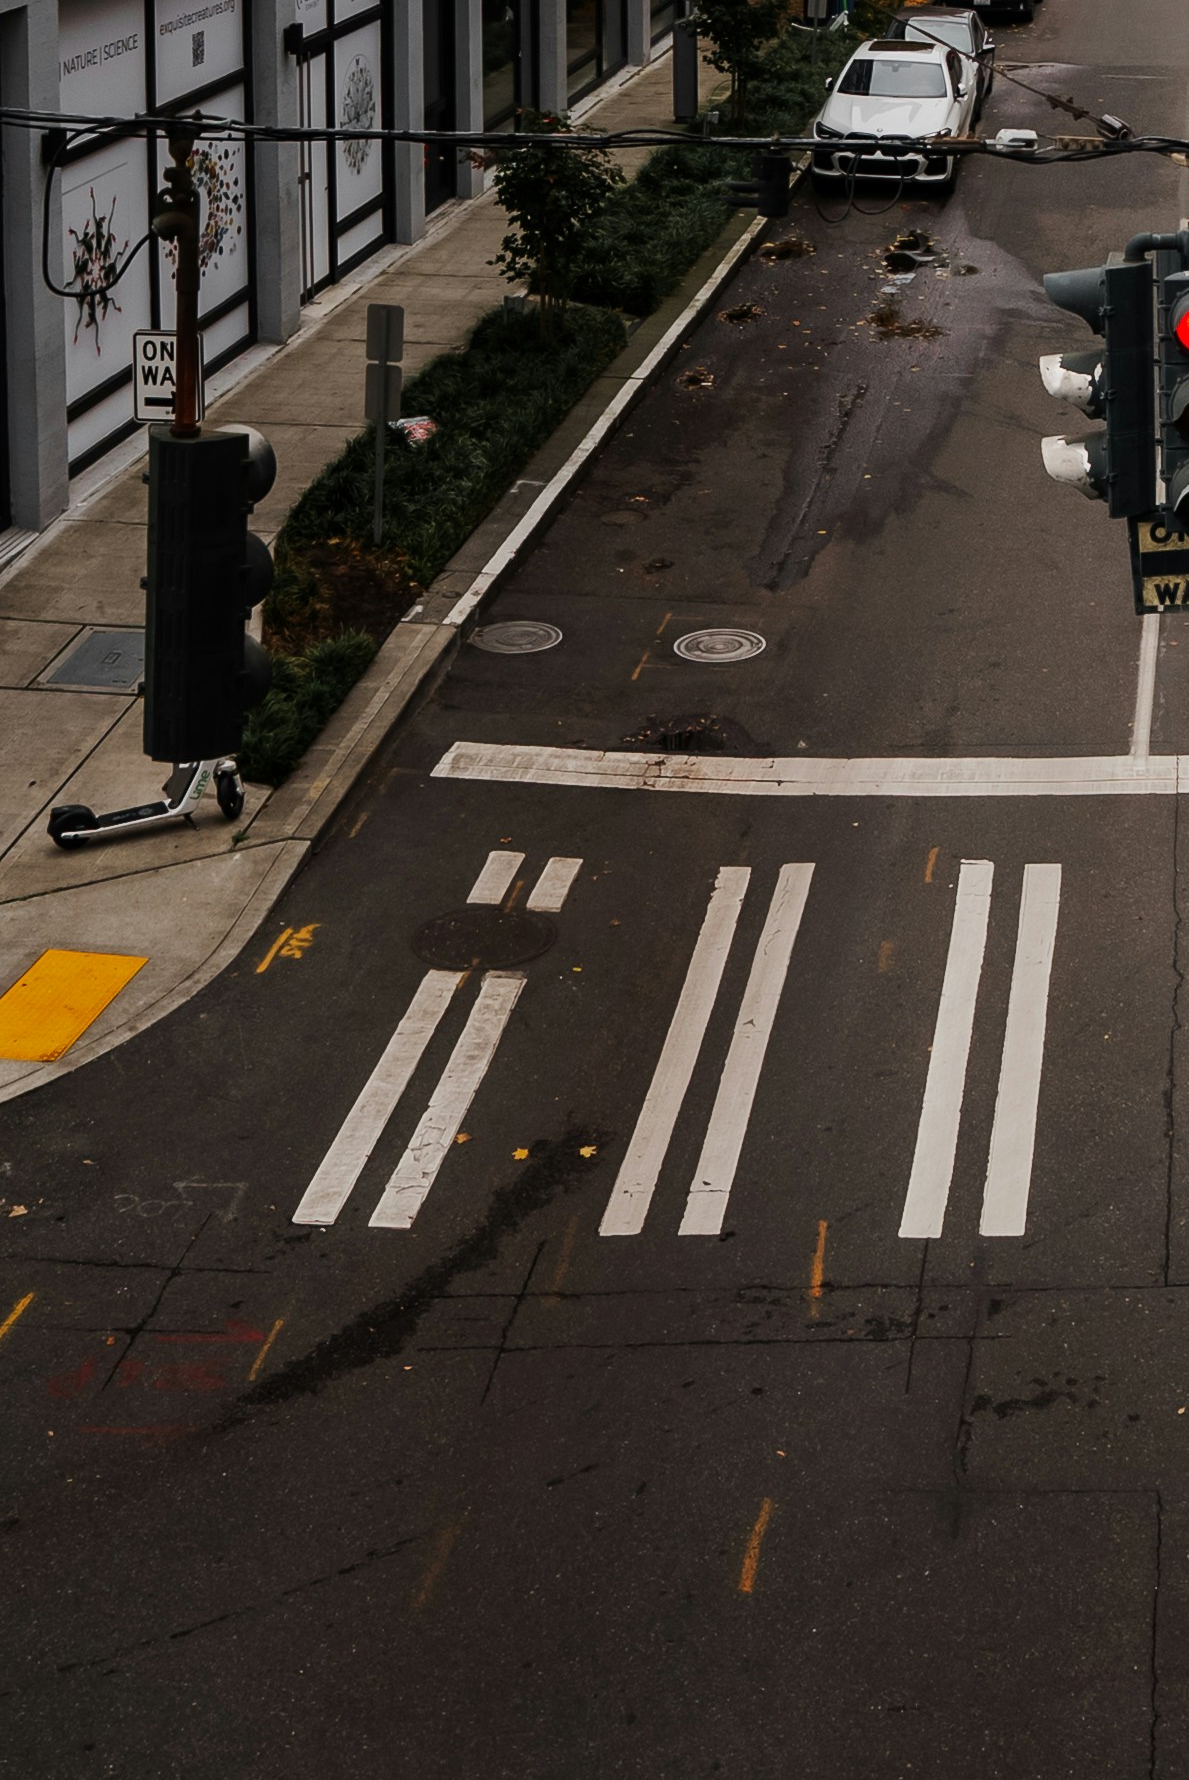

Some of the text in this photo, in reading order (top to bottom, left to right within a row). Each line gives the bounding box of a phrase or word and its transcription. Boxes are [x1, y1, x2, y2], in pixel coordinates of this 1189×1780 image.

[63, 33, 139, 76] NATURE SCIENCE
[142, 340, 175, 362] ON
[141, 365, 177, 387] WA
